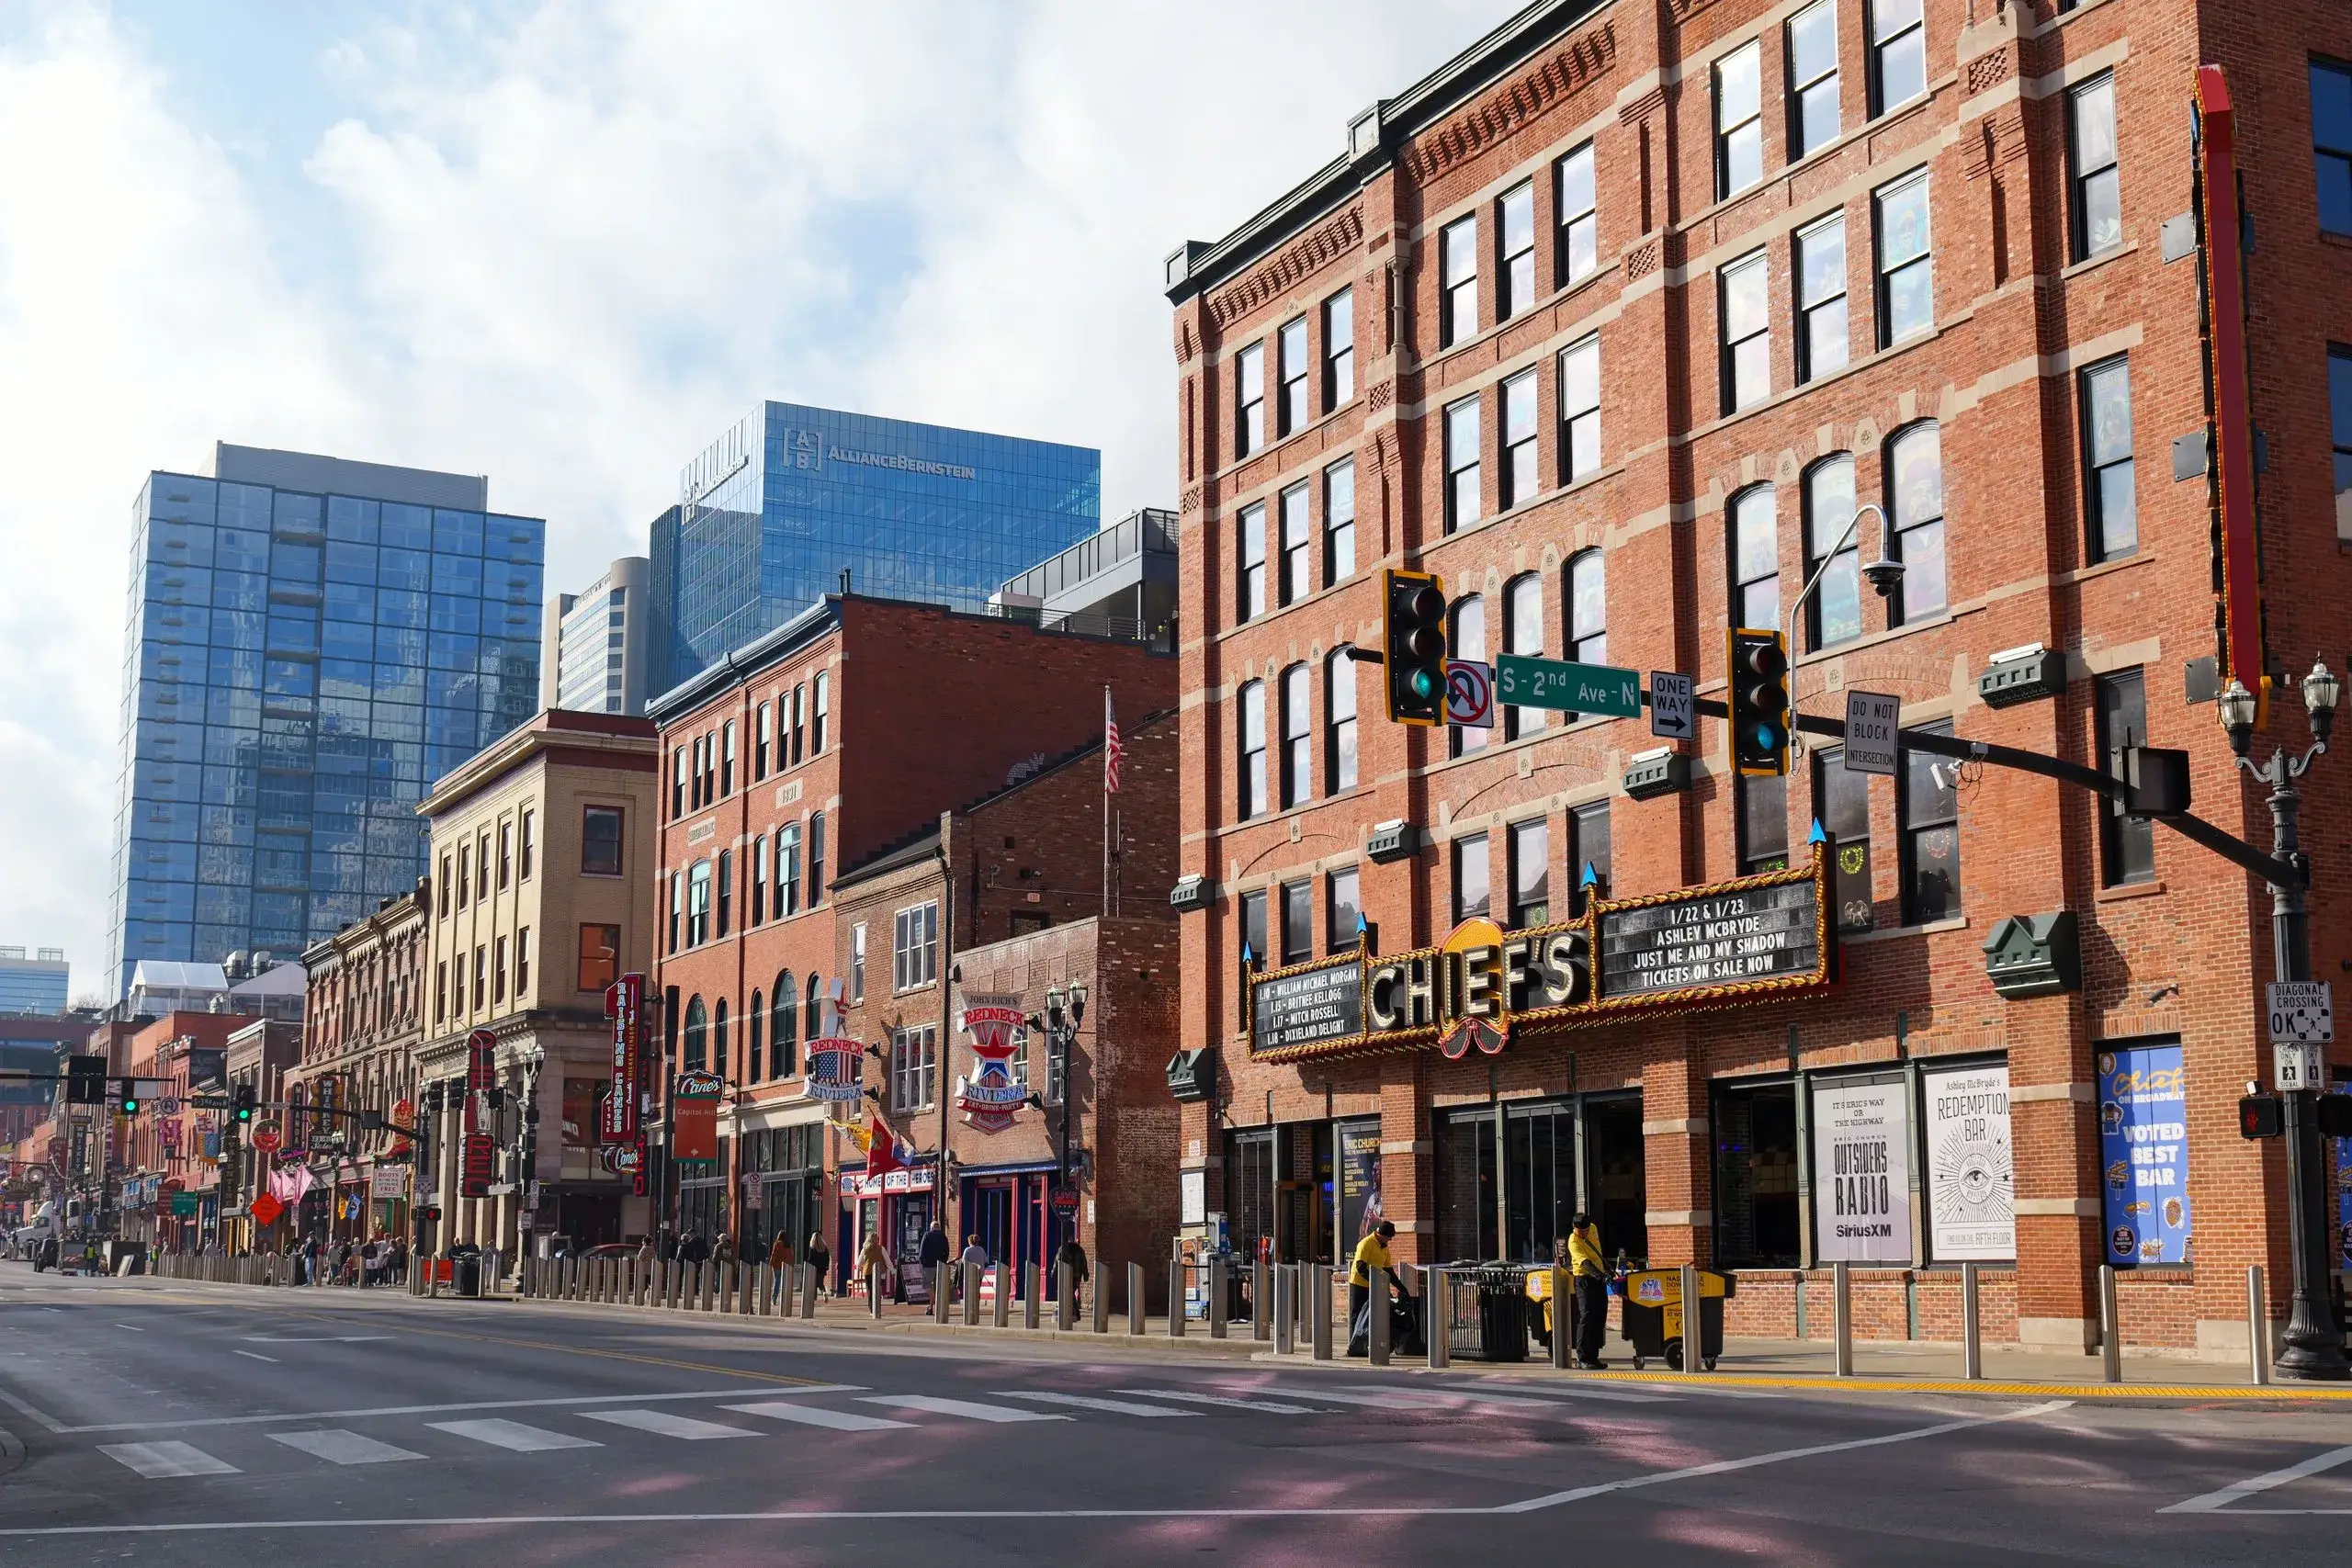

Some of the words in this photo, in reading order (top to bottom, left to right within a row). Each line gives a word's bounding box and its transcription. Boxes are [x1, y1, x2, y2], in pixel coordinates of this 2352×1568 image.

[1657, 678, 1688, 695] ONE
[1656, 695, 1690, 714] WAY
[1853, 700, 1867, 716] DO
[1873, 703, 1894, 720] NOT
[1853, 723, 1889, 742] BLOCK
[1848, 749, 1895, 768] INTERSECTION
[1671, 906, 1698, 925] 1/22
[1702, 905, 1711, 919] &
[1715, 898, 1744, 919] 1/23
[1657, 926, 1701, 946] ASHLEY
[1634, 950, 1663, 969] JUST
[1668, 946, 1683, 964] ME
[1689, 943, 1711, 962] AND
[1715, 941, 1732, 958] MY
[1736, 932, 1785, 954] SHADOW
[1642, 966, 1689, 987] TICKETS
[1693, 963, 1710, 979] ON
[1713, 959, 1743, 977] SALE
[1747, 954, 1773, 972] NOW
[1259, 987, 1271, 1001] 1.10
[1277, 979, 1300, 996] WILLIAM
[1301, 975, 1329, 993] MICHAEL
[1329, 967, 1357, 987] MORGAN
[1367, 931, 1576, 1031] CHIEF'S
[2276, 985, 2324, 996] DIAGONAL
[969, 995, 990, 1004] JOHN
[991, 996, 1017, 1006] RICH'S
[1271, 999, 1282, 1014] 1.15
[1287, 995, 1313, 1010] BRITNEE
[1314, 988, 1342, 1005] KELLOGG
[2277, 997, 2324, 1008] CROSSING
[615, 982, 627, 1067] RAISING
[965, 1008, 1024, 1025] REDNECK
[1272, 1015, 1284, 1029] 1.17
[1290, 1010, 1308, 1026] MITCH
[1309, 1004, 1339, 1021] ROSSELL
[2272, 1012, 2296, 1034] OK
[1267, 1032, 1279, 1045] 1.18
[1285, 1025, 1317, 1043] DIXIELAND
[1318, 1019, 1344, 1036] DELIGHT
[809, 1039, 865, 1056] REDNECK
[809, 1085, 862, 1100] RIVIERA
[966, 1084, 1024, 1102] RIVIERA
[1946, 1079, 1966, 1092] Ashley
[1967, 1077, 2000, 1089] McBryde's
[613, 1072, 624, 1134] CANES
[1869, 1099, 1885, 1107] WAY
[1938, 1093, 2011, 1121] REDEMPTION
[2119, 1095, 2132, 1104] ON
[2133, 1091, 2185, 1103] BROADWAY
[677, 1108, 702, 1116] Capitol
[704, 1109, 716, 1117] Hill
[1835, 1119, 1850, 1127] THE
[1850, 1117, 1884, 1127] HIGHWAY
[1964, 1118, 1986, 1142] BAR
[2122, 1122, 2185, 1143] VOTED
[1345, 1138, 1358, 1150] ERIC
[1834, 1142, 1887, 1176] OUTSIDERS
[2131, 1145, 2178, 1165] BEST
[865, 1177, 881, 1189] HOME
[887, 1175, 895, 1186] OF
[896, 1172, 907, 1185] THE
[911, 1171, 934, 1184] HEROES
[2135, 1168, 2176, 1187] BAR
[1835, 1175, 1889, 1216] RADIO
[1836, 1224, 1892, 1237] SiriusXM
[1993, 1232, 2011, 1245] FLOOR
